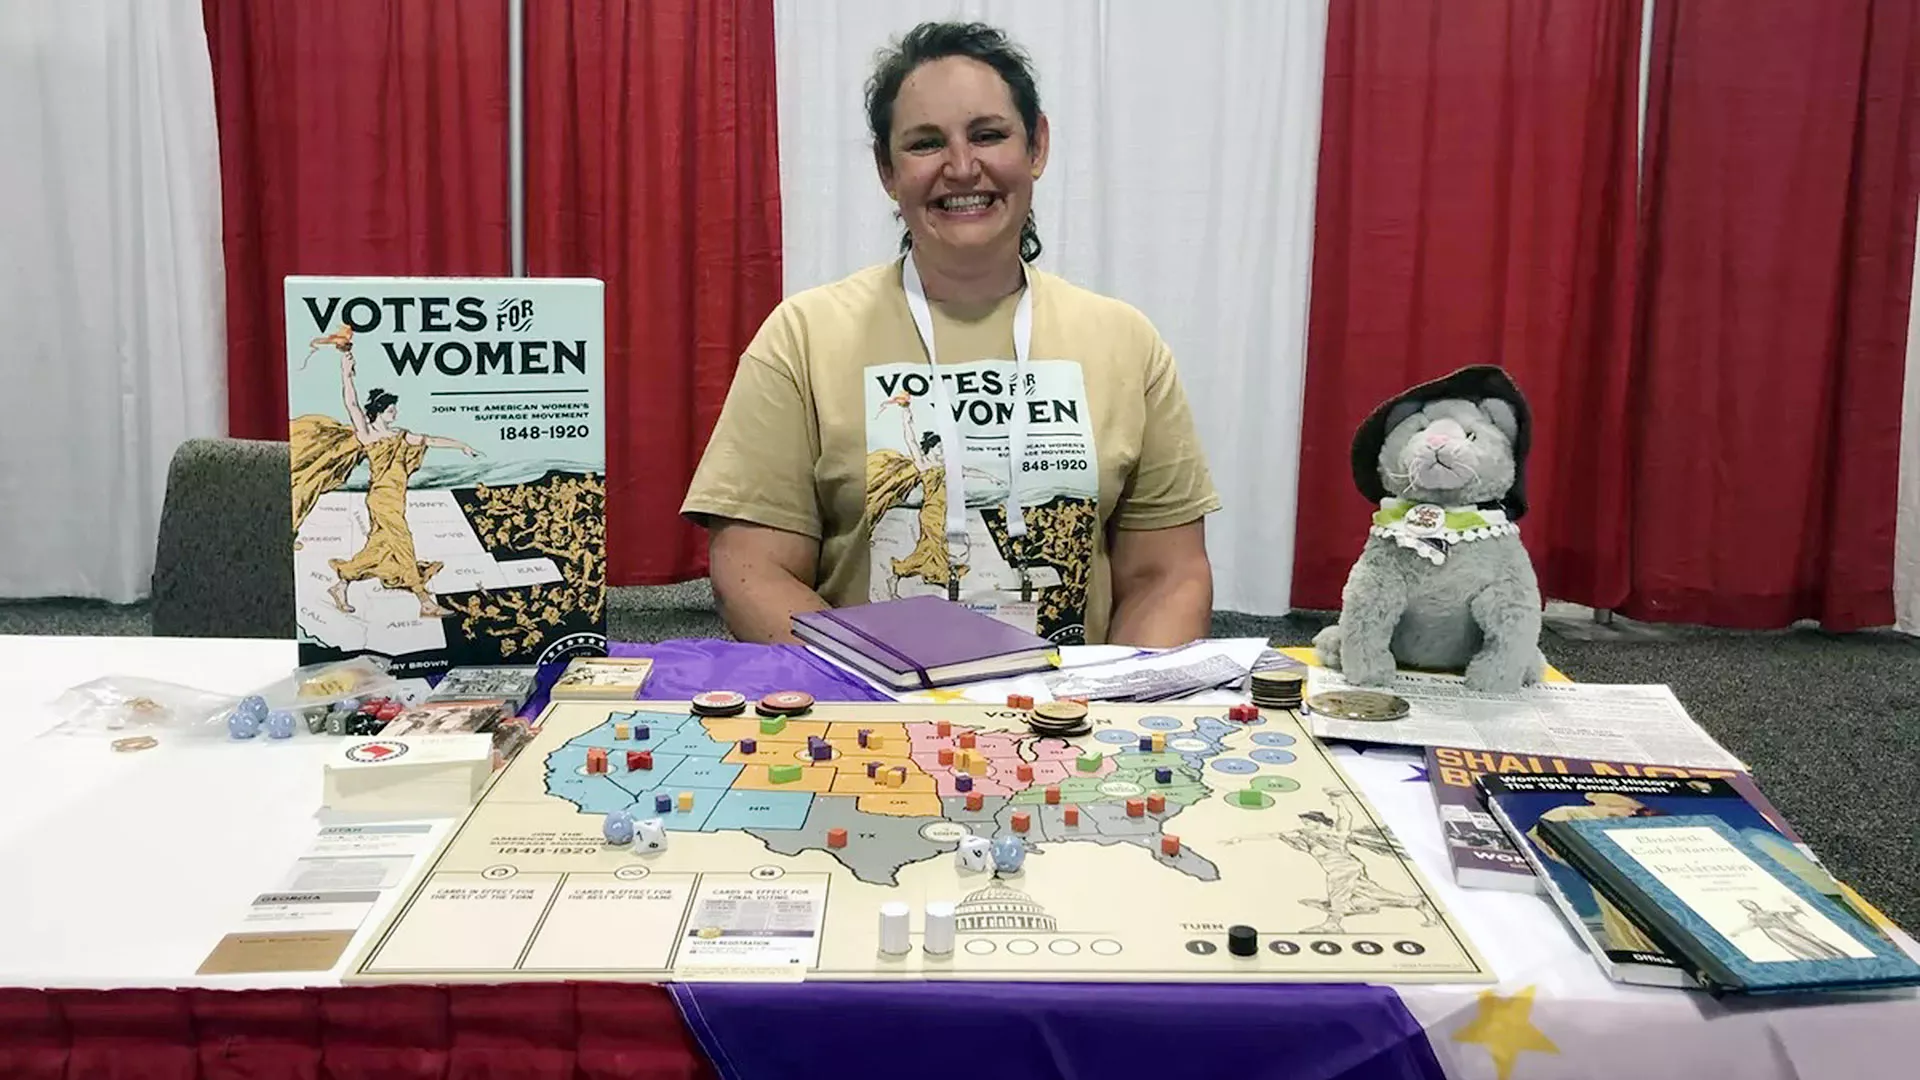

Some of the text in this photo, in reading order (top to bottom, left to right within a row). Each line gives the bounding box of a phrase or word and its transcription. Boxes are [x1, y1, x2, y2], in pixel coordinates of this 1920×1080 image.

[302, 296, 534, 333] VOTES FOR
[381, 340, 587, 376] WOMEN
[1009, 373, 1036, 396] FR
[484, 404, 538, 412] AMERICAN
[532, 412, 590, 420] MOVEMENT
[500, 425, 589, 440] 1848-1920
[1022, 459, 1087, 472] 848-1920
[409, 660, 449, 669] BROWN
[1499, 776, 1680, 789] Women Making History:
[1504, 782, 1670, 793] The 19th Amendment
[858, 832, 876, 840] TX
[497, 847, 597, 855] 1848-1920
[1473, 851, 1527, 864] WOM
[1179, 922, 1225, 930] TURN
